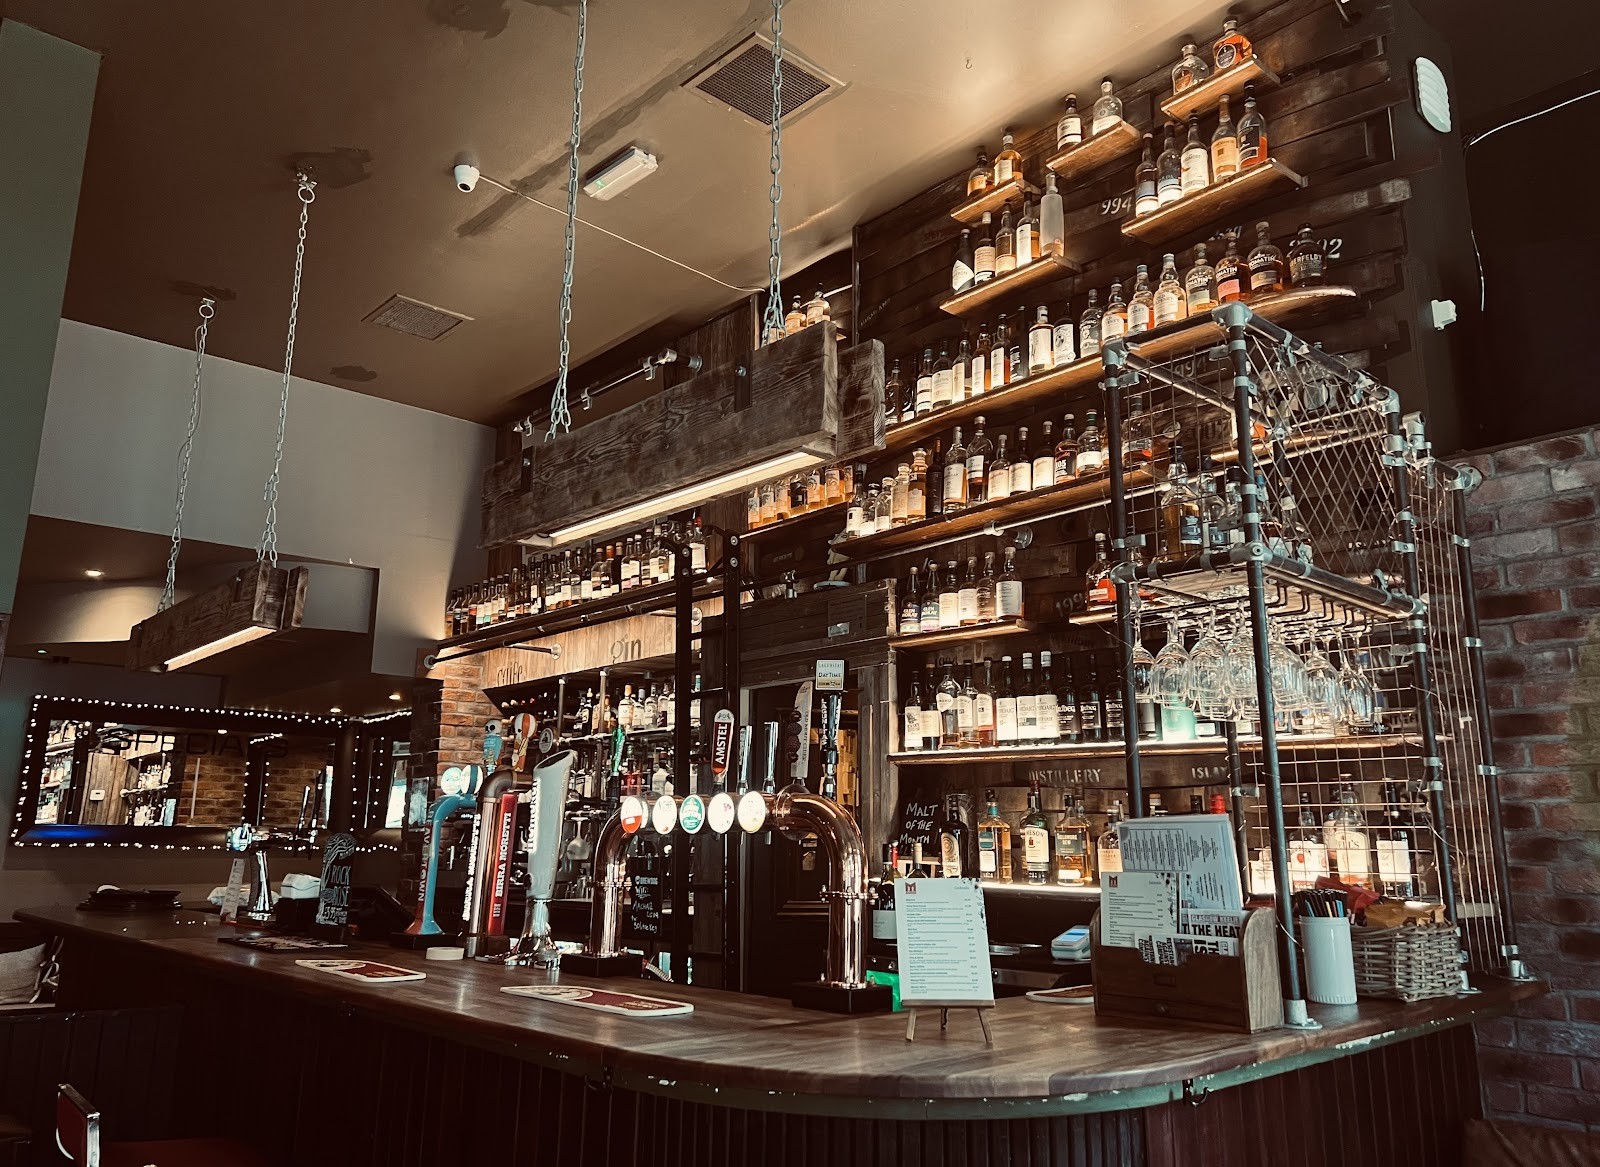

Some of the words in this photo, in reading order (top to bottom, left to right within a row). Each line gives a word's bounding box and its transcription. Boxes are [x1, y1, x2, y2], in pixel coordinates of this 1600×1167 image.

[610, 633, 642, 664] gin
[105, 728, 289, 758] SPECIAS
[714, 723, 728, 765] AMSTEL
[1029, 768, 1101, 783] DISTILLERY
[906, 802, 938, 817] MALT
[905, 820, 917, 831] OF
[917, 820, 934, 831] THE
[500, 812, 512, 861] MORETTI
[899, 832, 930, 844] MONTH
[331, 865, 351, 885] ROCK
[495, 863, 507, 897] BIRRA
[1192, 924, 1212, 936] THE
[1215, 925, 1241, 938] HEAT
